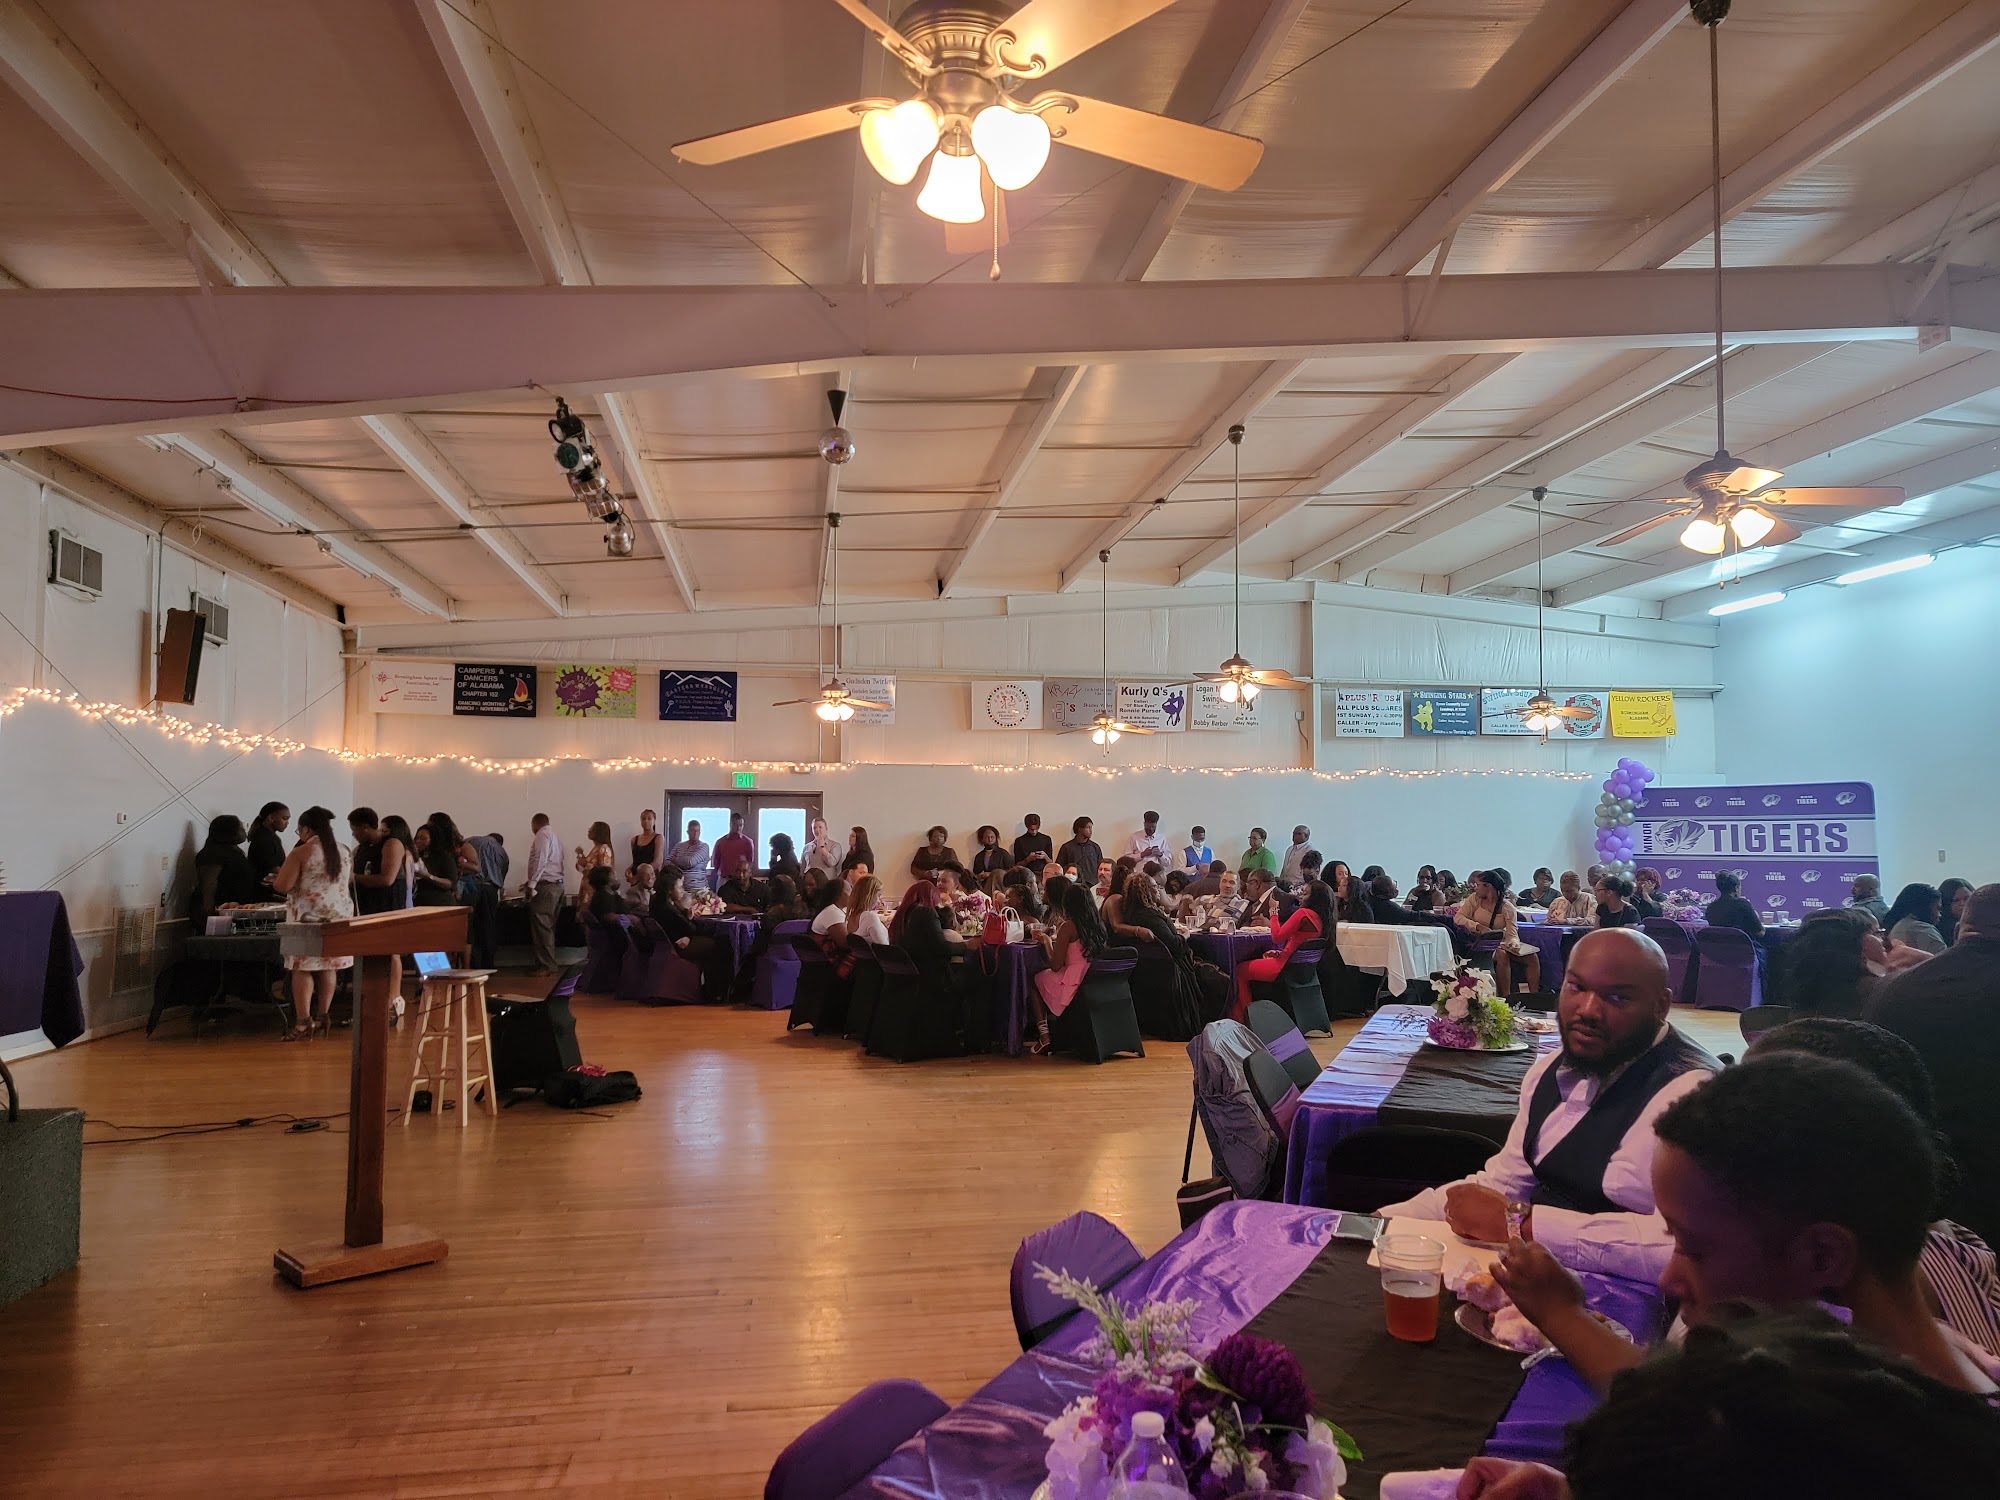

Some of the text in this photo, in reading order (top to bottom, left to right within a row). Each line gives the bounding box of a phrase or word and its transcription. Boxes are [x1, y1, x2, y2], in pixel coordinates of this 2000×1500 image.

[1047, 685, 1082, 698] KRAZY
[1121, 687, 1168, 698] Kurly Q's
[736, 774, 754, 788] EXIT
[1643, 823, 1848, 853] MINOR TIGERS
